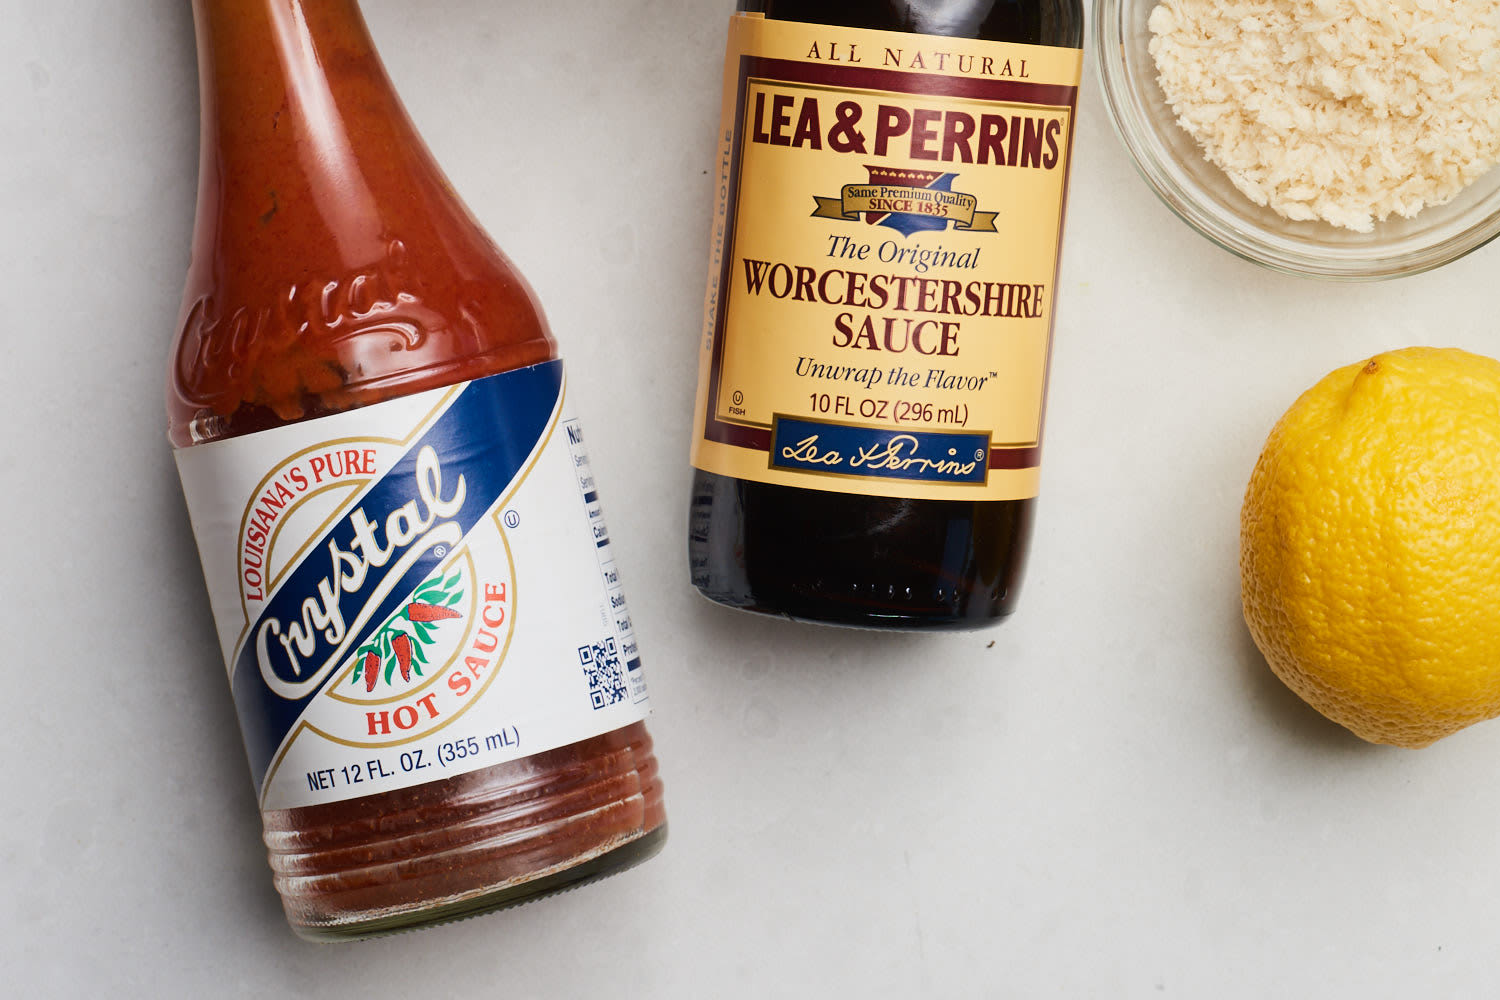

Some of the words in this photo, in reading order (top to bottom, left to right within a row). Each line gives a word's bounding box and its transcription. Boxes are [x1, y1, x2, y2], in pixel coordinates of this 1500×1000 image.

[807, 40, 862, 63] ALL
[883, 48, 1030, 79] NATURAL
[847, 186, 878, 200] Same
[879, 187, 932, 201] Premium
[934, 191, 974, 212] Quality
[868, 199, 913, 213] SINCE
[916, 200, 949, 217] 1835
[704, 276, 719, 352] SHAKE
[713, 225, 724, 266] THE
[719, 129, 732, 217] BOTTLE
[827, 234, 871, 260] The
[878, 240, 982, 274] Original
[742, 258, 1045, 319] WORCESTERSHIRE
[832, 312, 961, 357] SAUCE
[795, 357, 883, 386] Unwrap
[887, 366, 920, 387] the
[728, 407, 746, 417] FISH
[810, 393, 831, 413] 10
[835, 395, 854, 417] FL
[863, 398, 888, 419] OZ
[893, 400, 933, 423] (296
[937, 403, 969, 427] mL)
[782, 435, 843, 466] Lea
[876, 434, 976, 476] Perrins
[244, 467, 309, 602] LOUISIANA'S
[309, 449, 377, 484] PURE
[256, 444, 467, 700] Crystal
[365, 692, 440, 736] HOT
[447, 582, 506, 697] SAUCE
[307, 769, 335, 792] NET
[341, 764, 364, 785] 12
[368, 758, 395, 780] FL.
[400, 749, 432, 772] OZ.
[437, 736, 480, 768] (355
[486, 725, 521, 752] mL)
